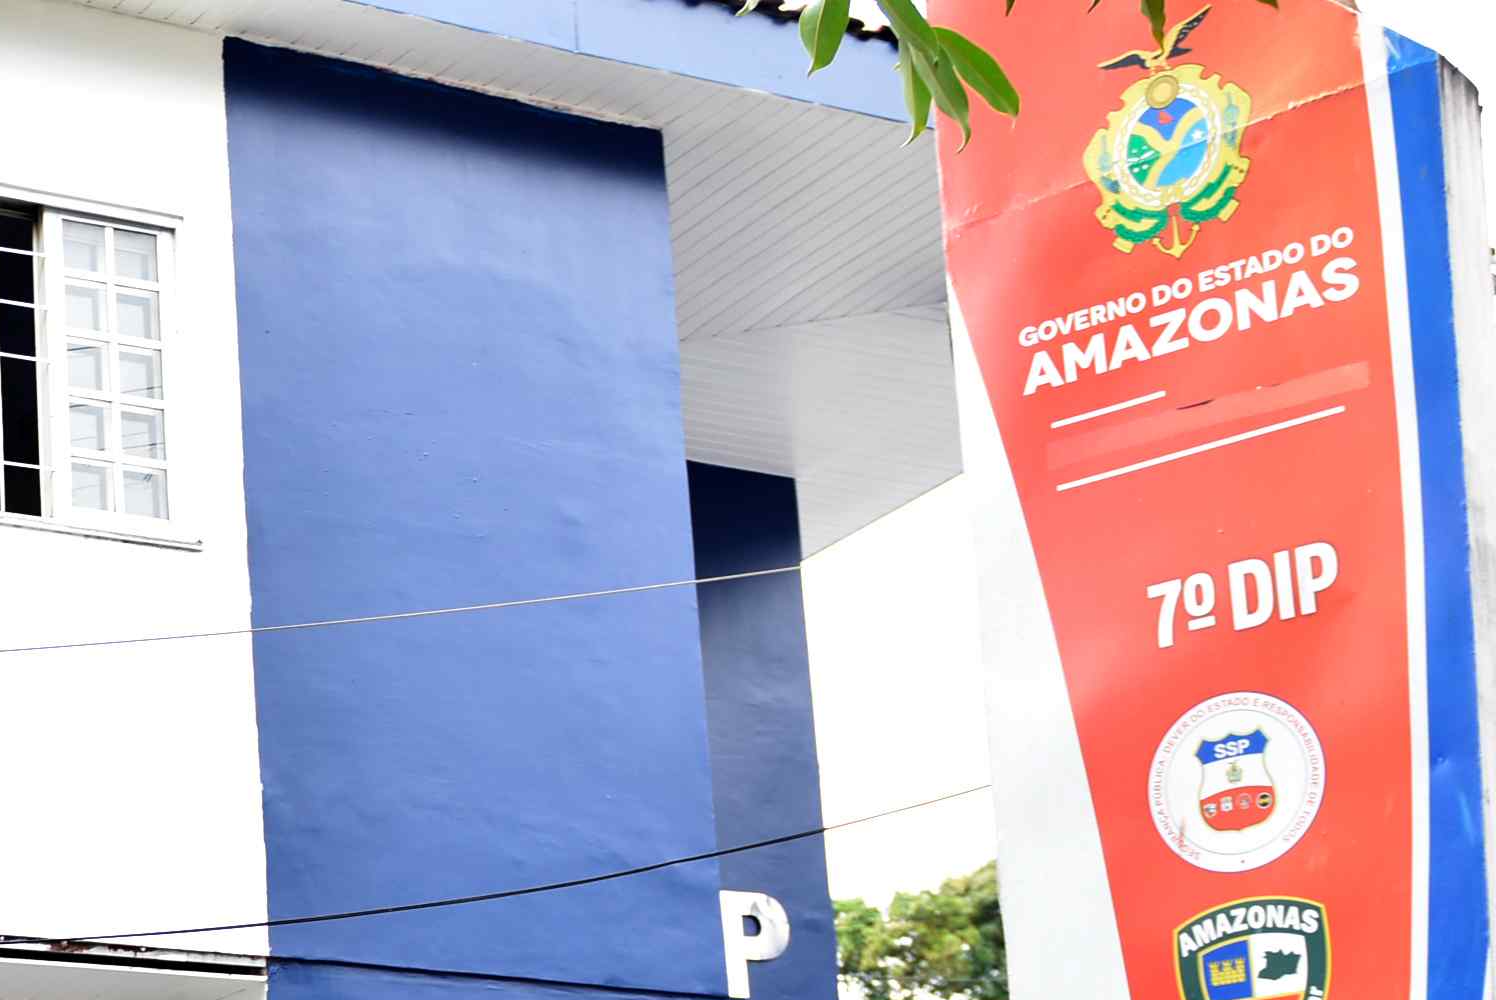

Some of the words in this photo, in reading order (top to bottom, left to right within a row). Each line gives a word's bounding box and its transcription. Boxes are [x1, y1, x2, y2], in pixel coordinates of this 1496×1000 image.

[1018, 292, 1147, 348] GOVERNO
[1151, 277, 1193, 308] DO
[1198, 242, 1305, 293] ESTADO
[1309, 226, 1354, 257] DO
[1022, 256, 1361, 397] AMAZONAS
[1228, 541, 1339, 632] DIP
[1213, 737, 1251, 759] SSP
[719, 890, 790, 999] P
[1179, 904, 1320, 958] AMAZONAS
